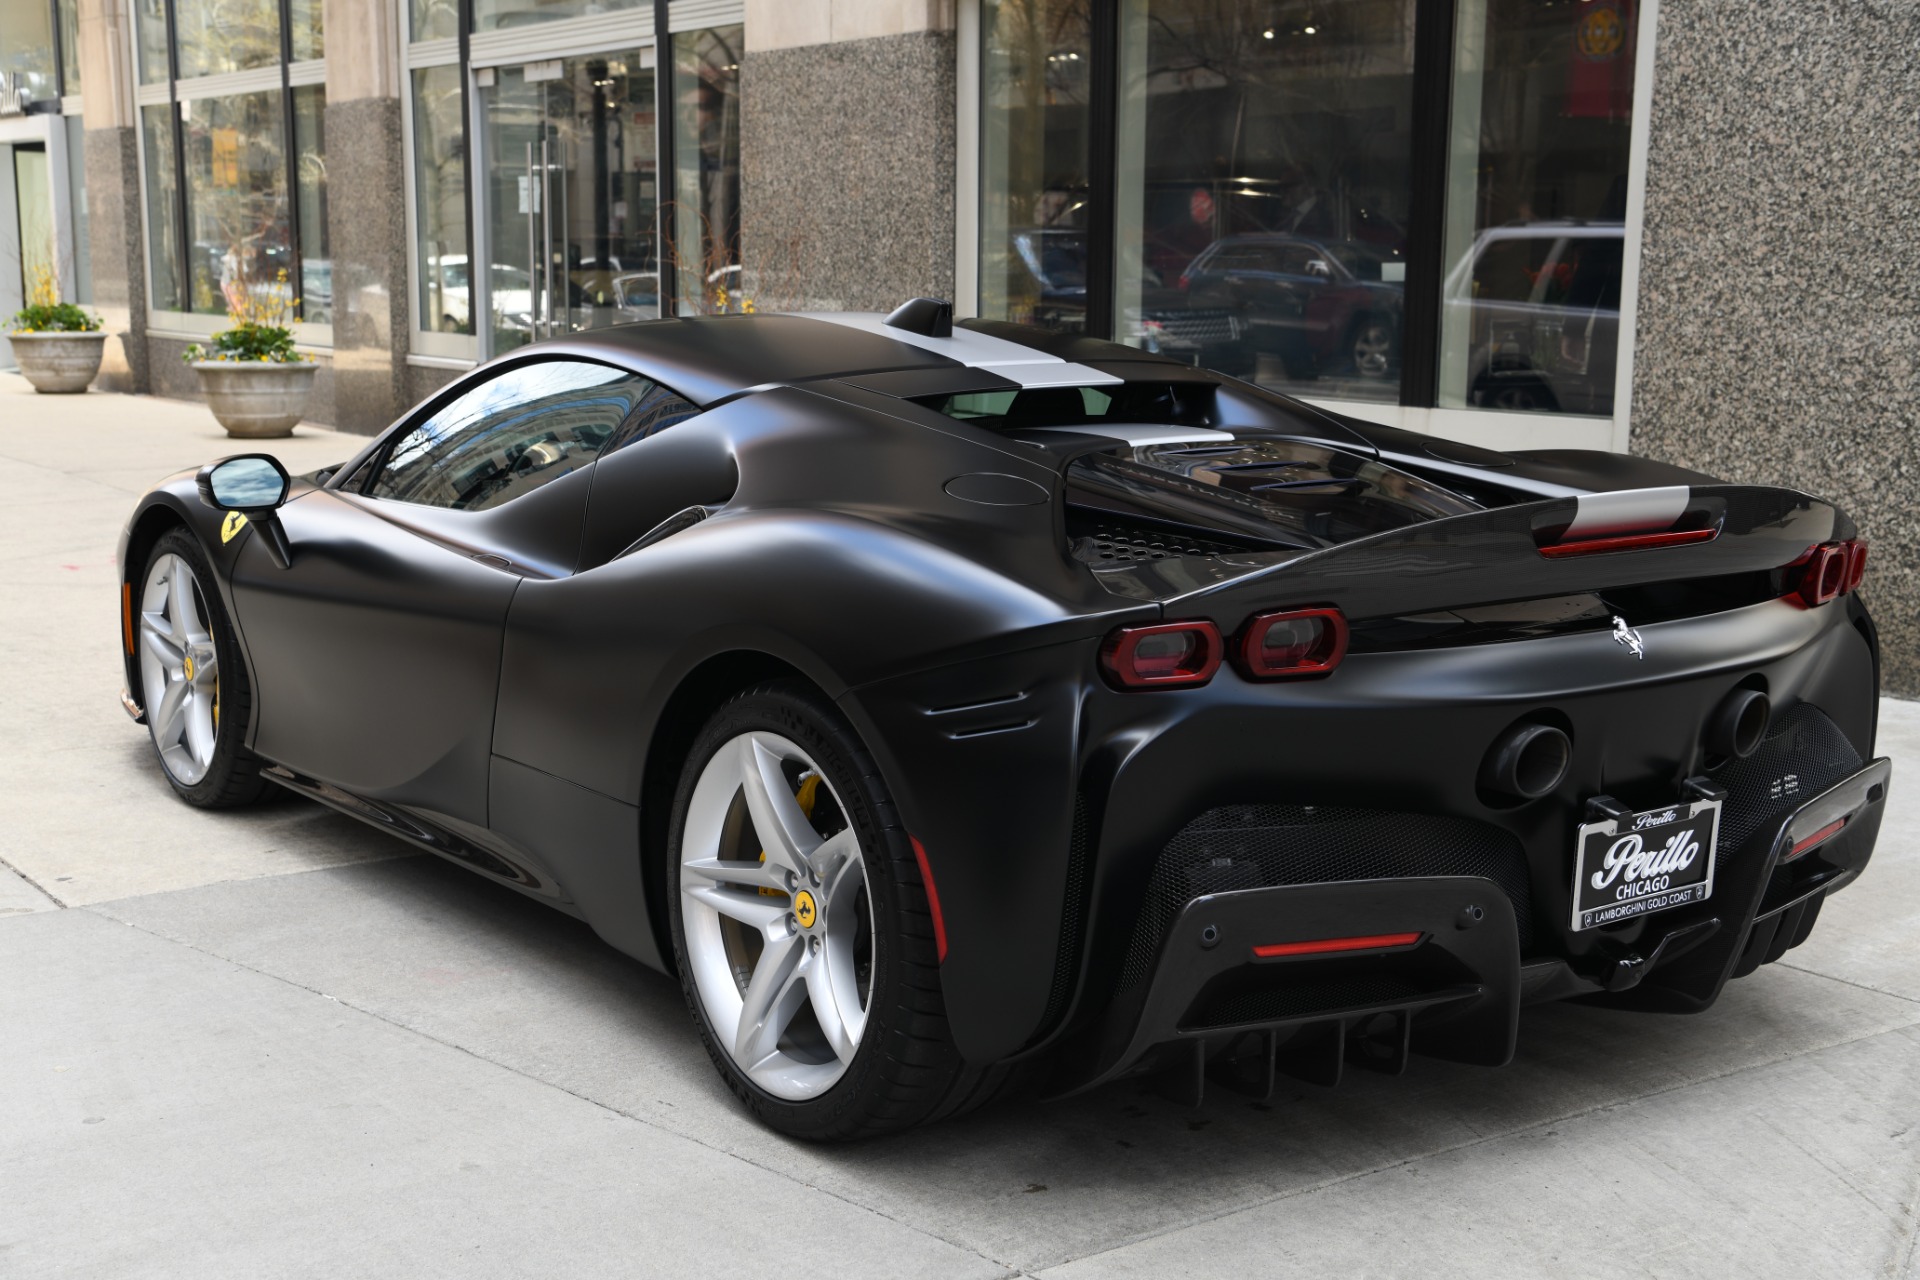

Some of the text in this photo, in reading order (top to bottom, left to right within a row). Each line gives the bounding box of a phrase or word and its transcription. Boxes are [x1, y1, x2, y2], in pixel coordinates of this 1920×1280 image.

[1631, 809, 1677, 831] Perillo
[1591, 829, 1700, 890] Perillo
[1616, 875, 1670, 900] CHICAGO
[1595, 890, 1692, 923] LAMBORGHINI GOLD COAST
